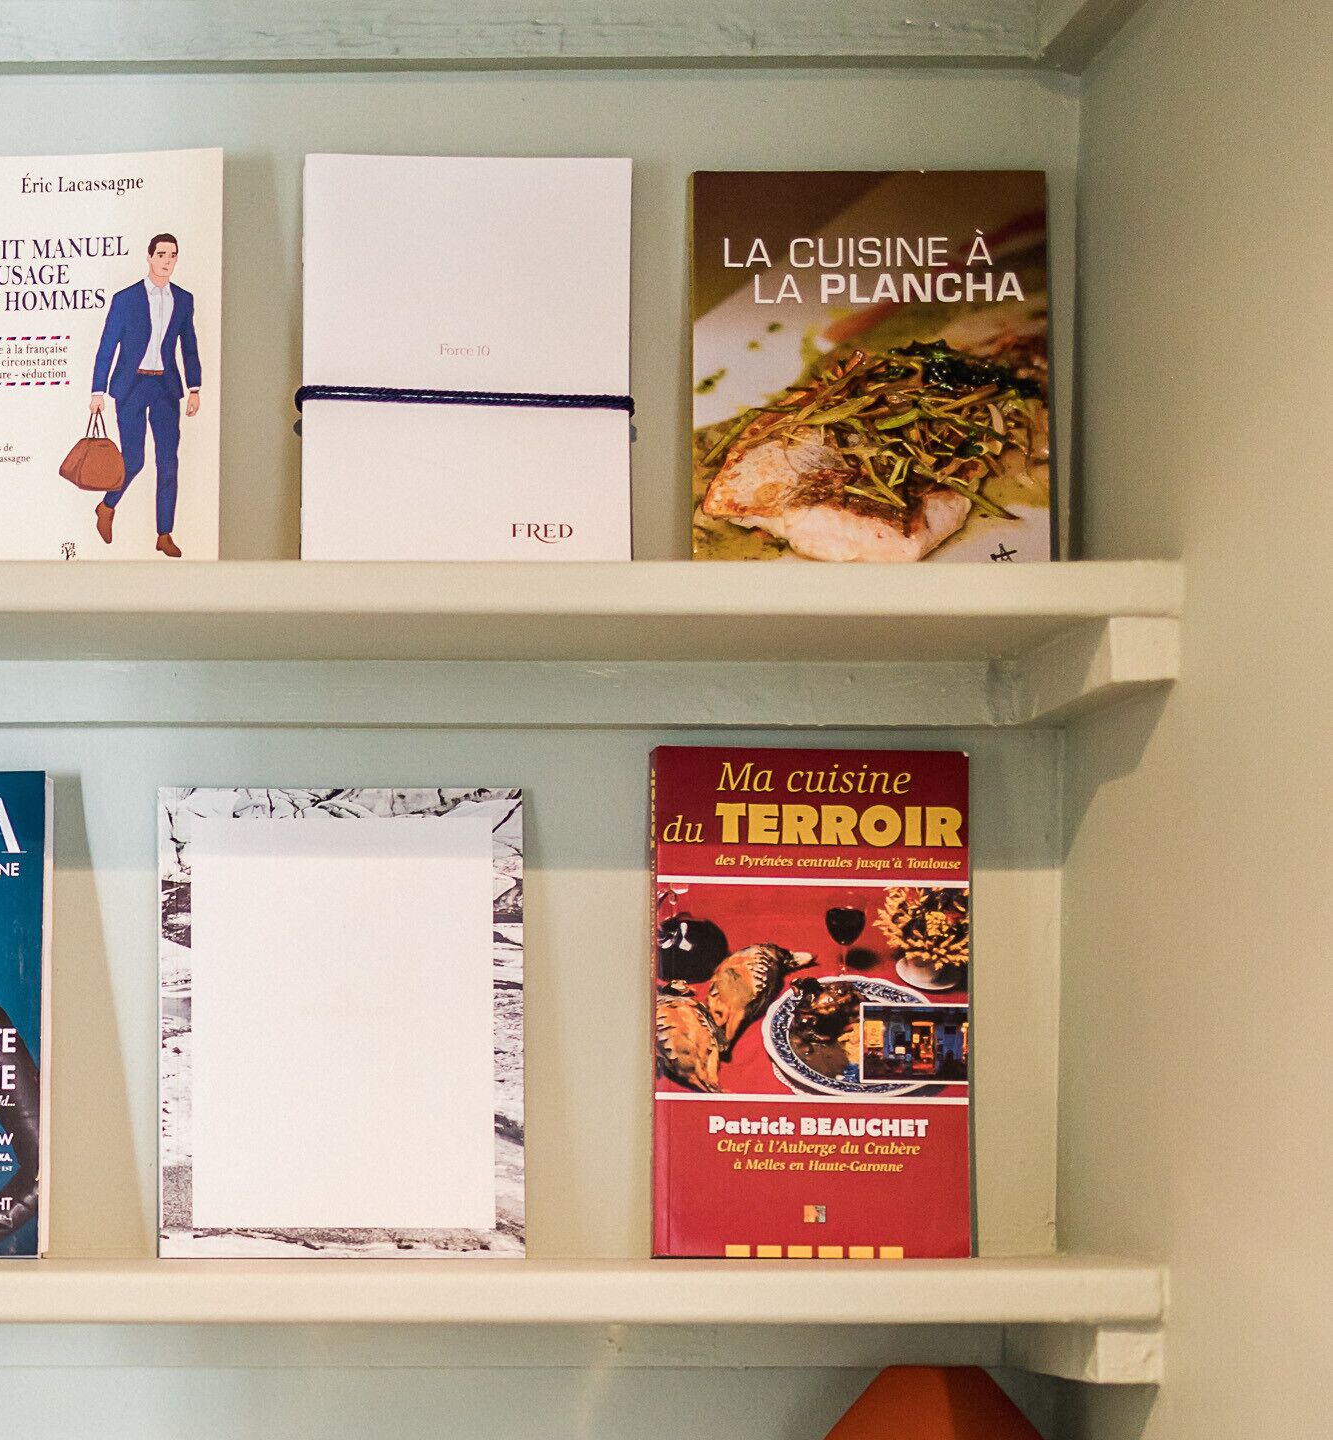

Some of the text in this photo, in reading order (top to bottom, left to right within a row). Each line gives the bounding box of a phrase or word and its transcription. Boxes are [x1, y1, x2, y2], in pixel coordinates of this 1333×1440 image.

[21, 173, 144, 196] Éric Lacassagne
[32, 235, 130, 259] MANUEL
[724, 229, 993, 269] LA CUISINE À
[754, 271, 1025, 304] LA PLANCHA
[5, 288, 106, 312] HOMMES
[6, 345, 12, 354] à
[14, 345, 23, 354] la
[26, 343, 68, 356] française
[440, 343, 491, 357] Force 10
[1, 356, 68, 367] circonstances
[21, 368, 67, 379] séduction
[4, 443, 14, 452] de
[511, 523, 574, 544] FRED
[716, 762, 912, 795] Ma cuisine
[663, 802, 963, 848] du TERROIR
[715, 854, 962, 872] des Pyrénées centrales jusqu'à Toulouse
[708, 1115, 929, 1139] Patrick BEAUCHET
[717, 1139, 921, 1158] Chef à l'Auberge du Crabère
[733, 1159, 904, 1173] à Melles en Haute-Garonne
